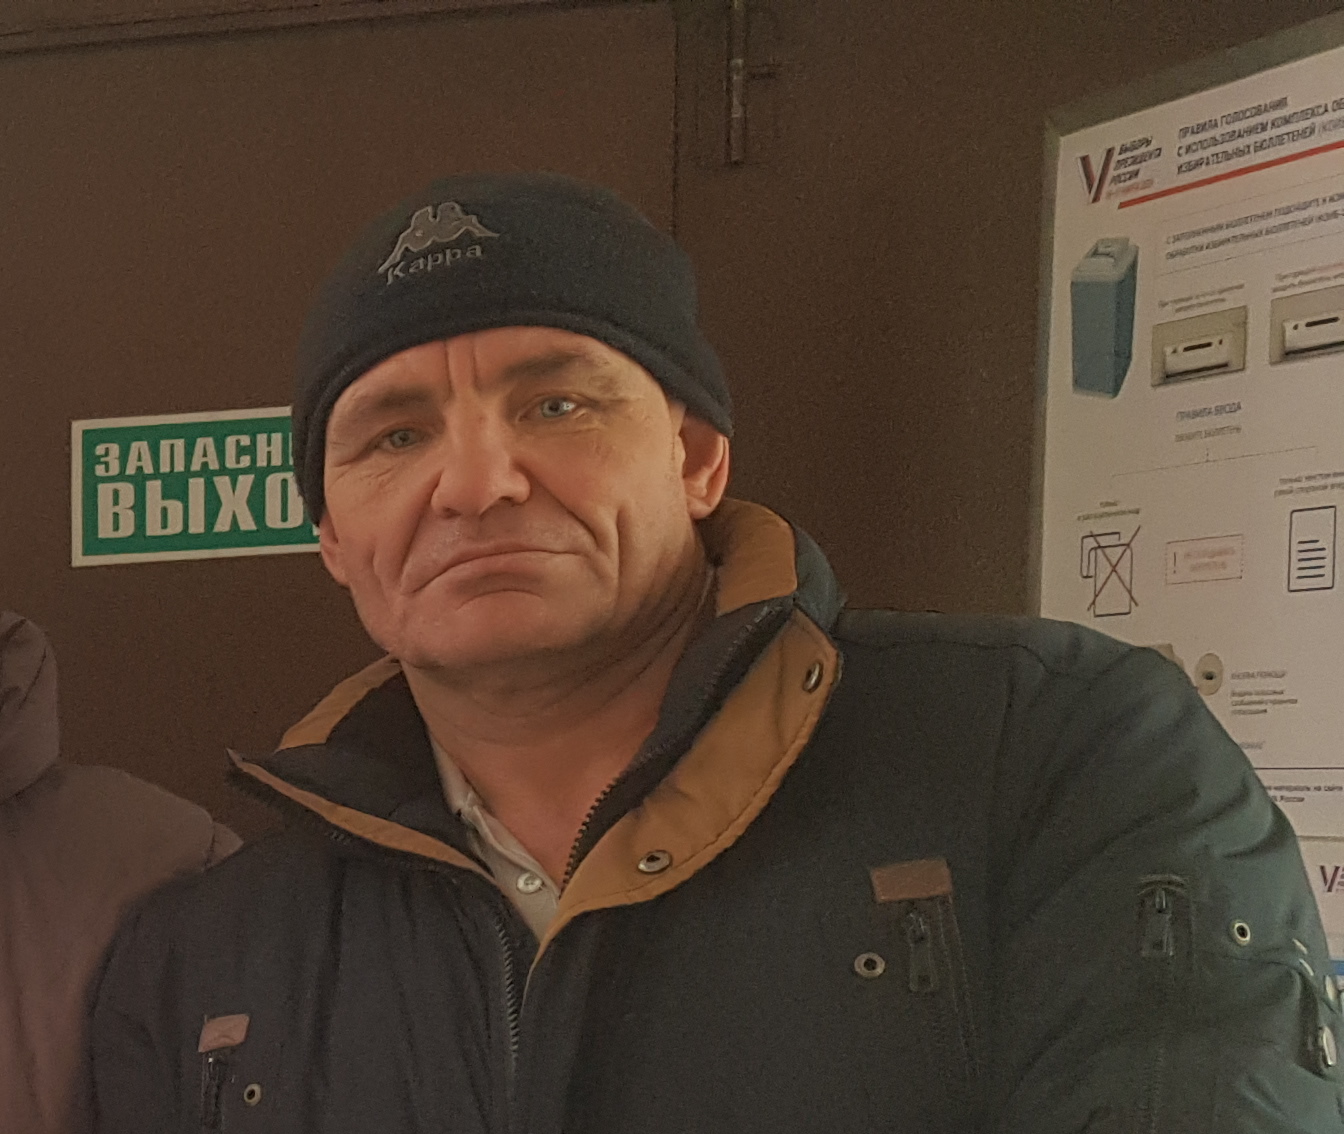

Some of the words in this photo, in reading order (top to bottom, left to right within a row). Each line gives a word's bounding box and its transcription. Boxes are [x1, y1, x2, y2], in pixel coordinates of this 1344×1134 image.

[386, 244, 483, 286] Kappa
[94, 431, 294, 478] ЗАПАСН
[97, 471, 320, 539] ВЫХО
